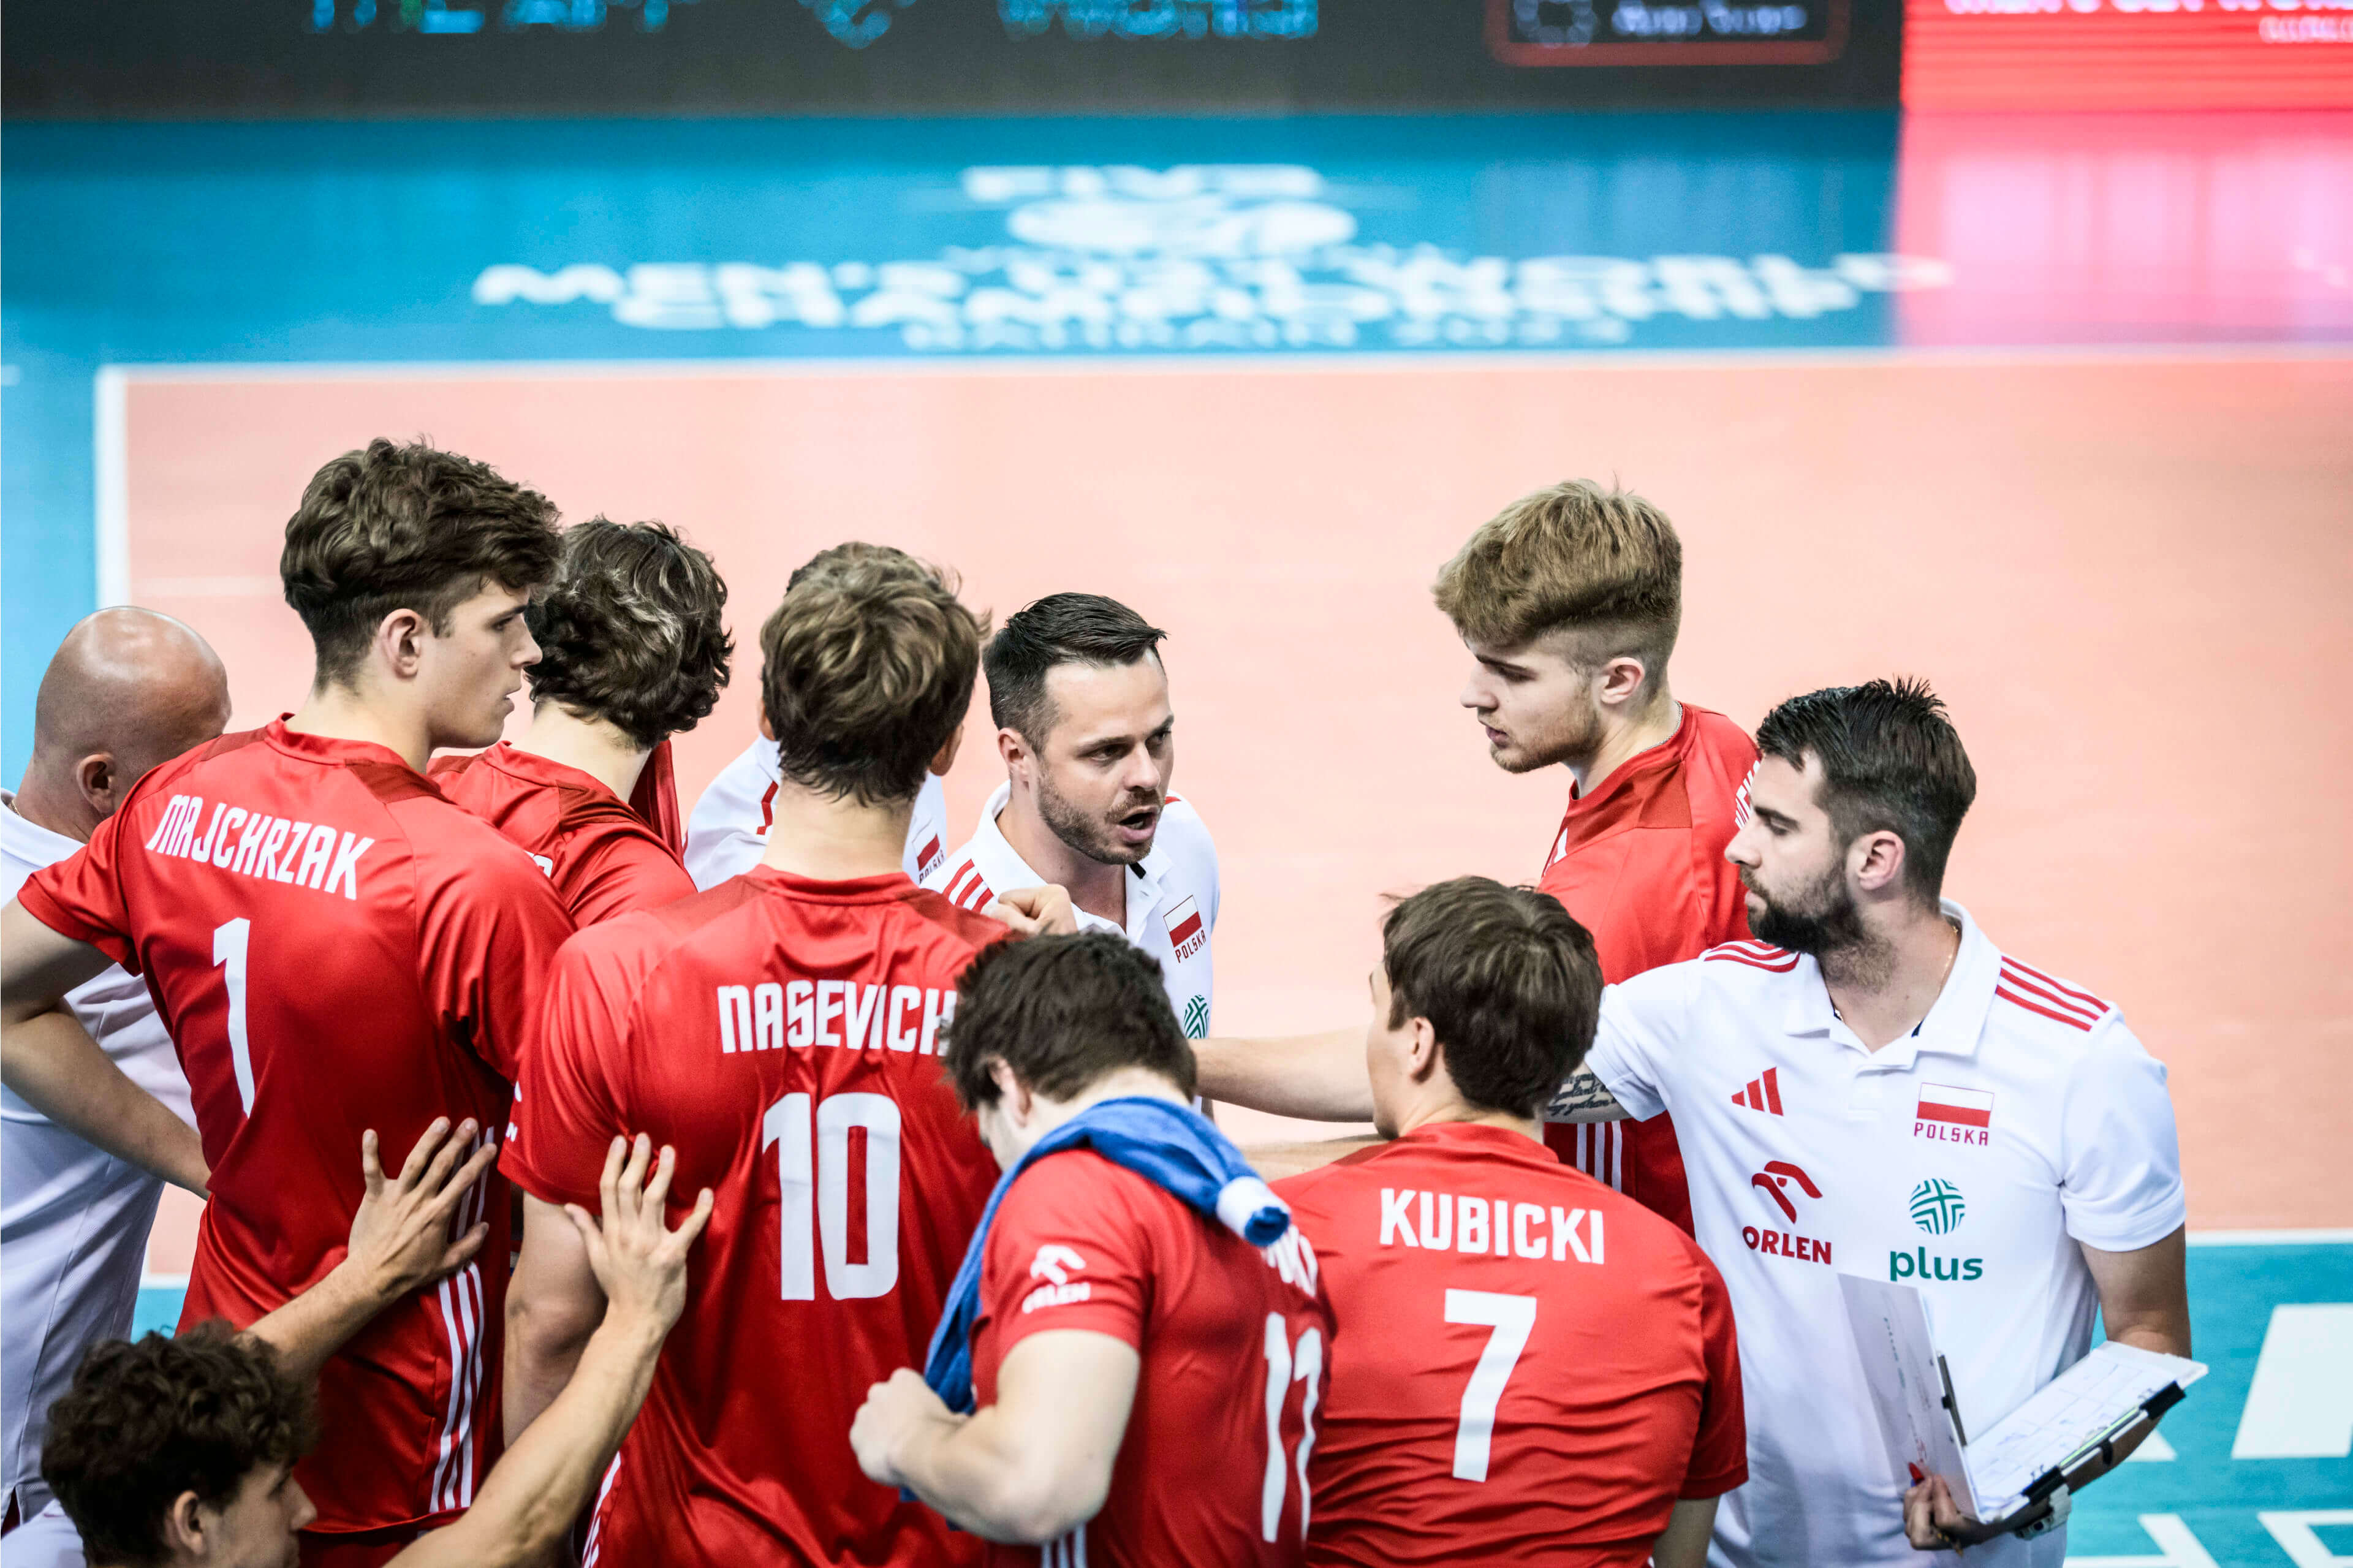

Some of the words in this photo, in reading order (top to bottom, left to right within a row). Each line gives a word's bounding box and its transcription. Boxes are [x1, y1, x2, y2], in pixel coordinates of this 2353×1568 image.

[145, 794, 376, 901] MAJCHRZAK
[1175, 929, 1207, 964] POLSKA
[213, 917, 255, 1119] 1
[717, 980, 957, 1057] NASEVICH
[1914, 1122, 1988, 1146] POLSKA
[762, 1093, 901, 1301] 10
[1379, 1187, 1605, 1265] KUBICKI
[1742, 1225, 1832, 1265] ORLEN
[1890, 1246, 1984, 1282] plus
[1444, 1288, 1537, 1482] 7
